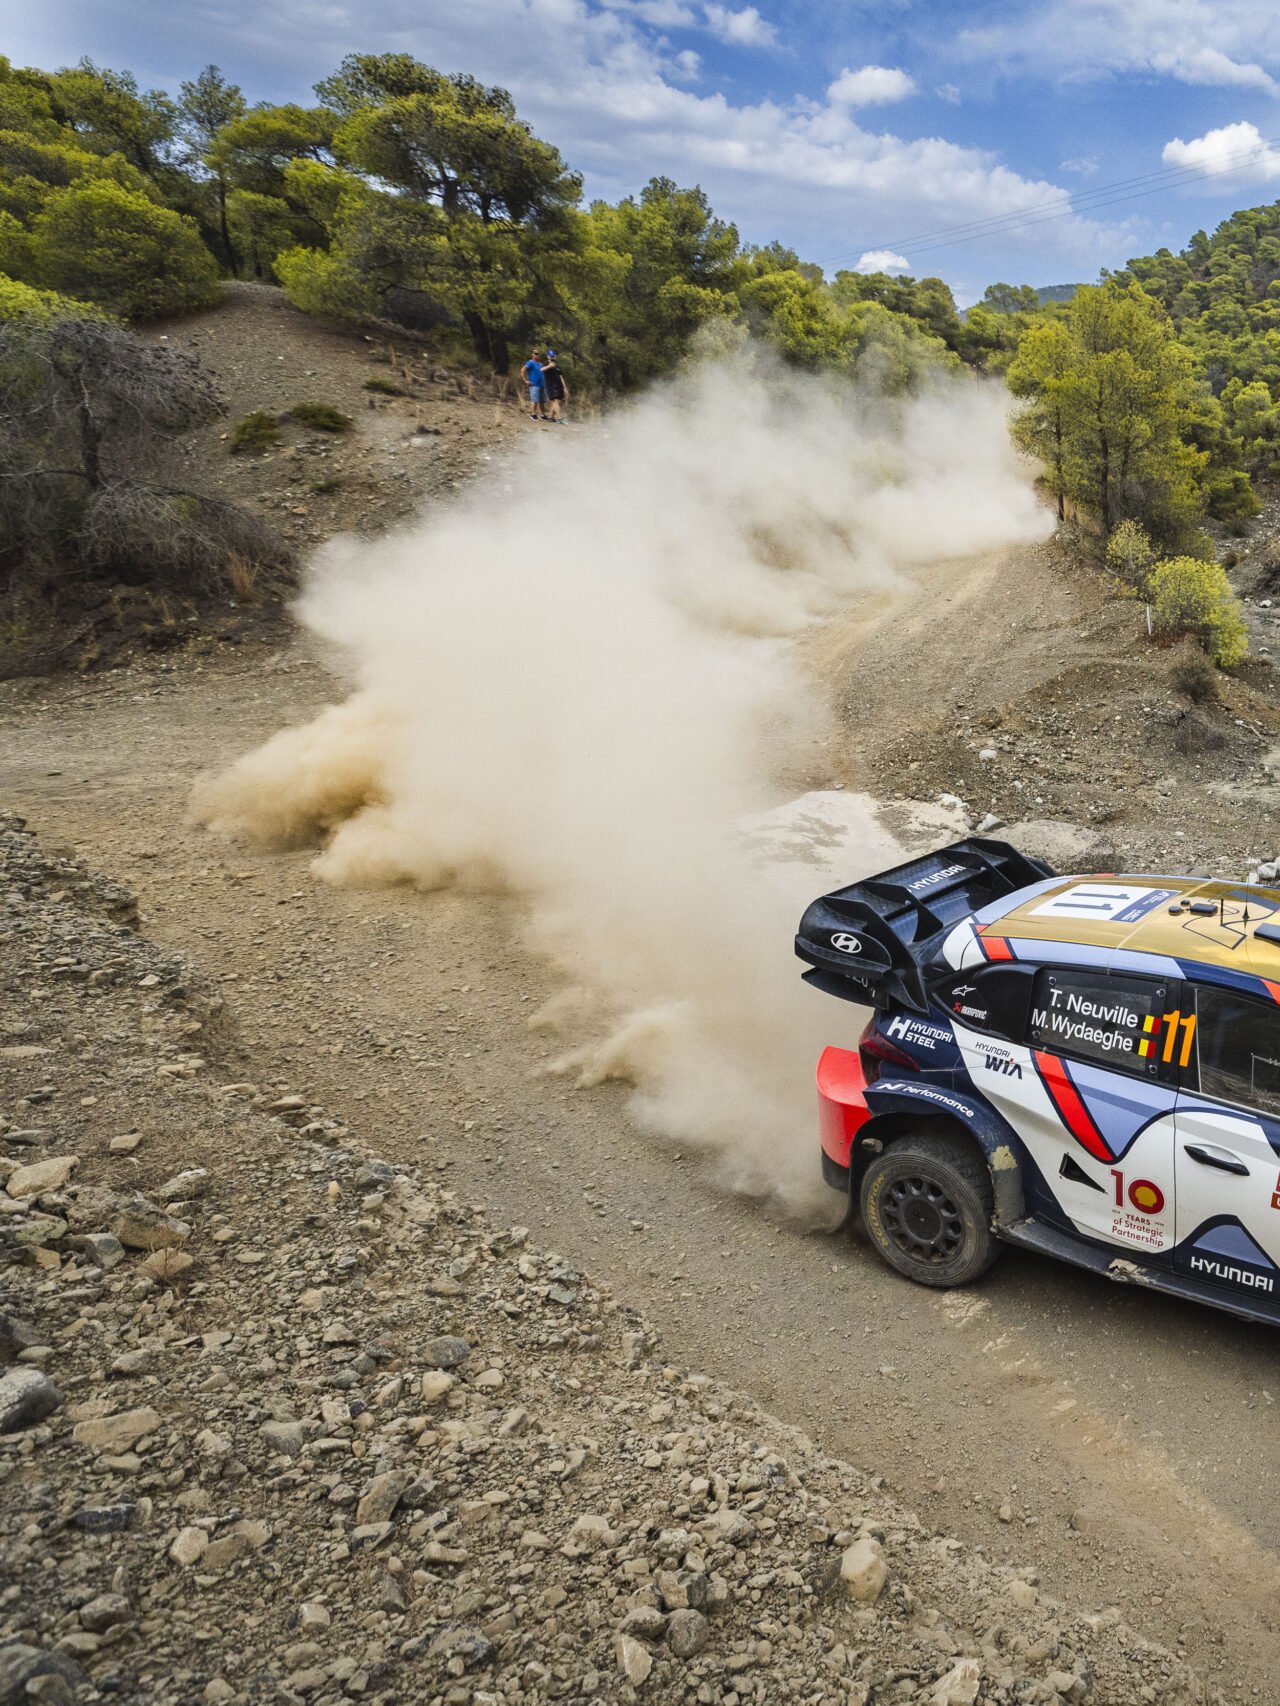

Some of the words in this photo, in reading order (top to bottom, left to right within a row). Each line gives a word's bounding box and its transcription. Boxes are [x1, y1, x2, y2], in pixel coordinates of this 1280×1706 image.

[909, 864, 966, 890] HYUNDAI
[1050, 989, 1062, 1008] T.
[1066, 996, 1139, 1028] Neuville
[905, 1032, 936, 1049] STEEL
[909, 1022, 953, 1043] HYUNDAI
[1052, 1014, 1134, 1051] Wydaeghe
[1162, 1009, 1196, 1067] 11
[975, 1041, 1011, 1058] HYUNDAI
[985, 1054, 1023, 1080] WIA
[903, 1086, 975, 1118] Performance
[1125, 1213, 1151, 1226] YEARS
[1125, 1220, 1164, 1237] Strategic
[1112, 1225, 1164, 1248] Partnership
[1191, 1256, 1274, 1292] HYUNDAI
